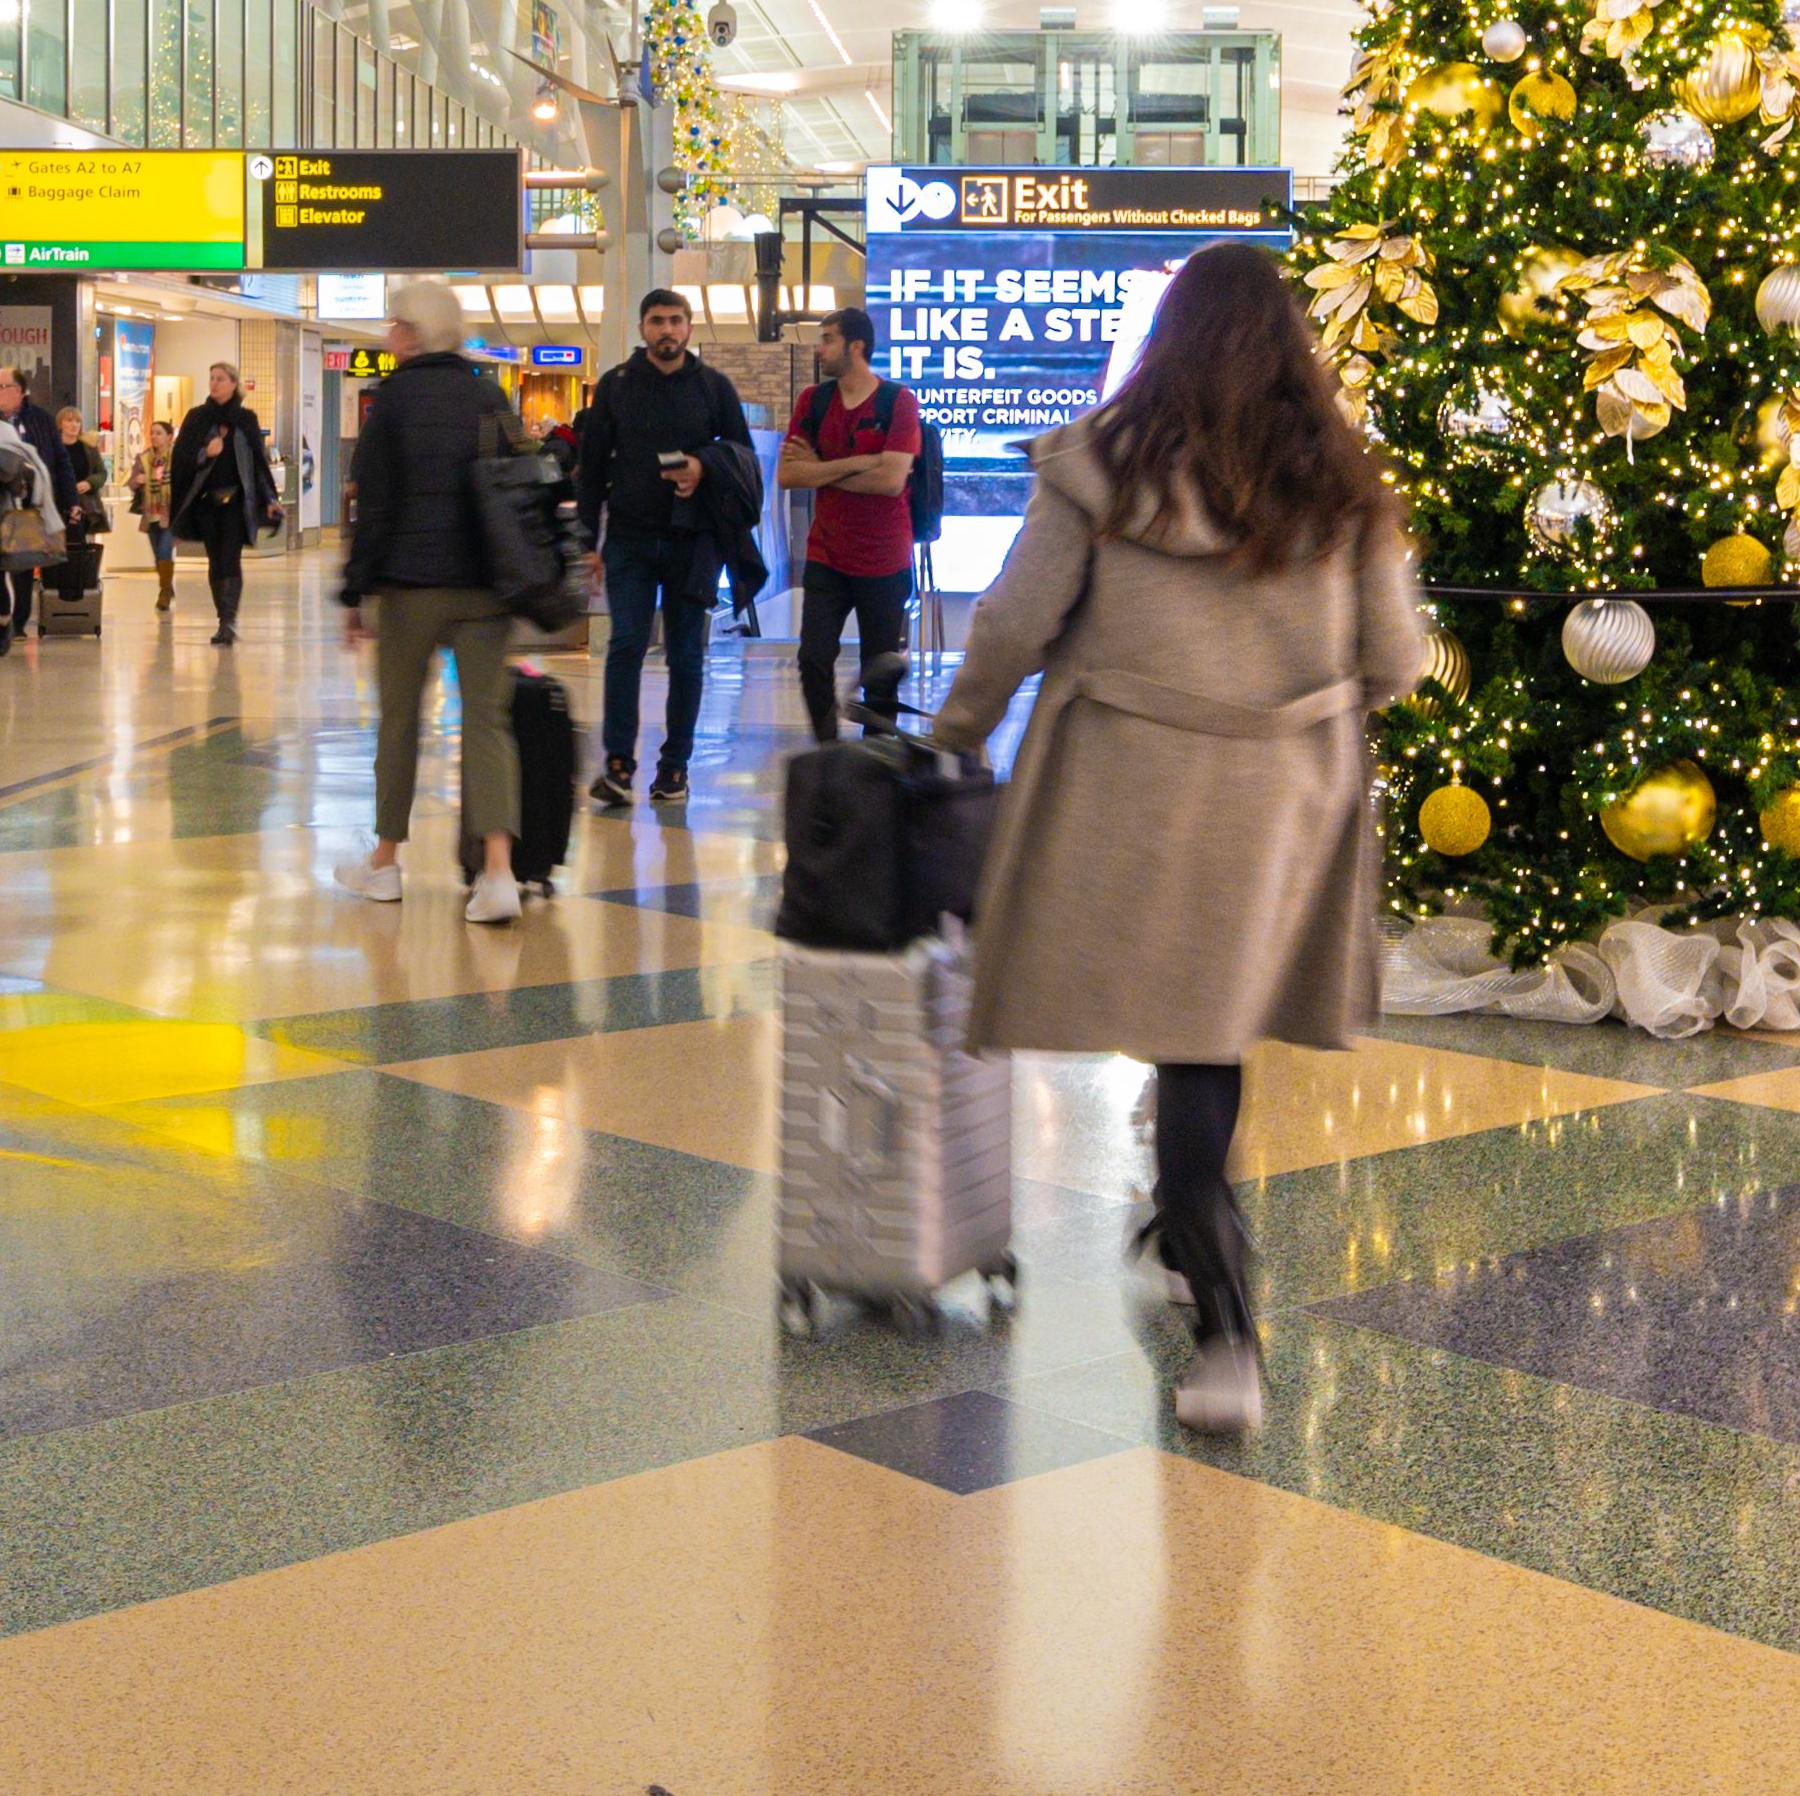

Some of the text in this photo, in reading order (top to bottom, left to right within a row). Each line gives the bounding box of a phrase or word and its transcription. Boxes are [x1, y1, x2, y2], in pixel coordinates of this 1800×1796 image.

[29, 161, 142, 174] Gates A2 to A7
[299, 159, 331, 175] Exit
[29, 185, 141, 201] Baggage Claim
[299, 184, 382, 200] Restrooms
[1014, 175, 1089, 210] Exit
[299, 208, 365, 224] Elevator
[1014, 210, 1260, 227] For Passengers Without Checked Bags
[29, 246, 90, 261] AirTrain
[890, 269, 1141, 303] IF IT SEEMS
[889, 308, 1131, 342] LIKE A STE
[327, 352, 347, 368] EXIT
[890, 346, 996, 379] IT IS.
[910, 389, 1097, 405] UNTERFEIT GOODS
[918, 408, 1071, 425] PORT CRIMINAL
